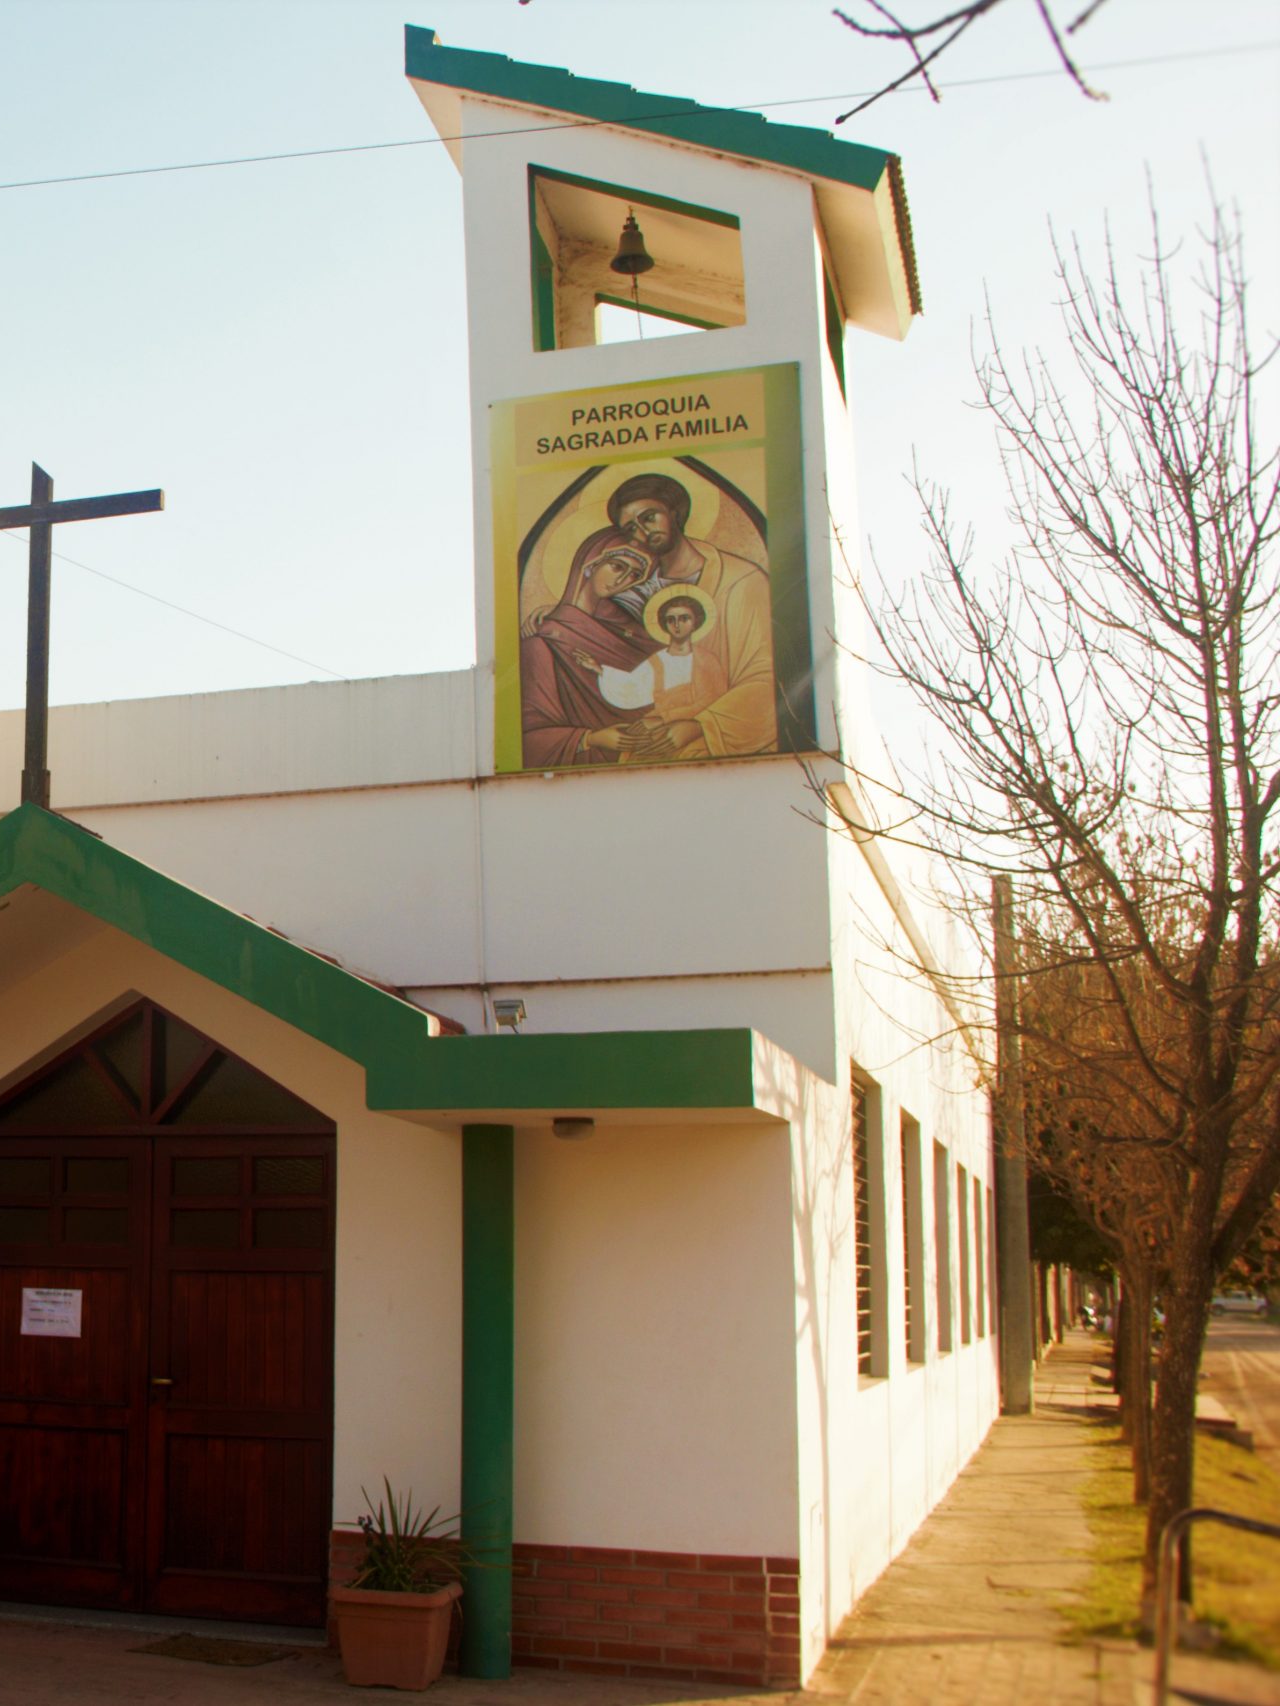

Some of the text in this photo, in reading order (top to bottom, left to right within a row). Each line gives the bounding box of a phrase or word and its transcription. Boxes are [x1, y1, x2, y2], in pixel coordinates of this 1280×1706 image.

[571, 394, 711, 426] PARROQUIA
[536, 414, 749, 455] SAGRADA FAMILIA
